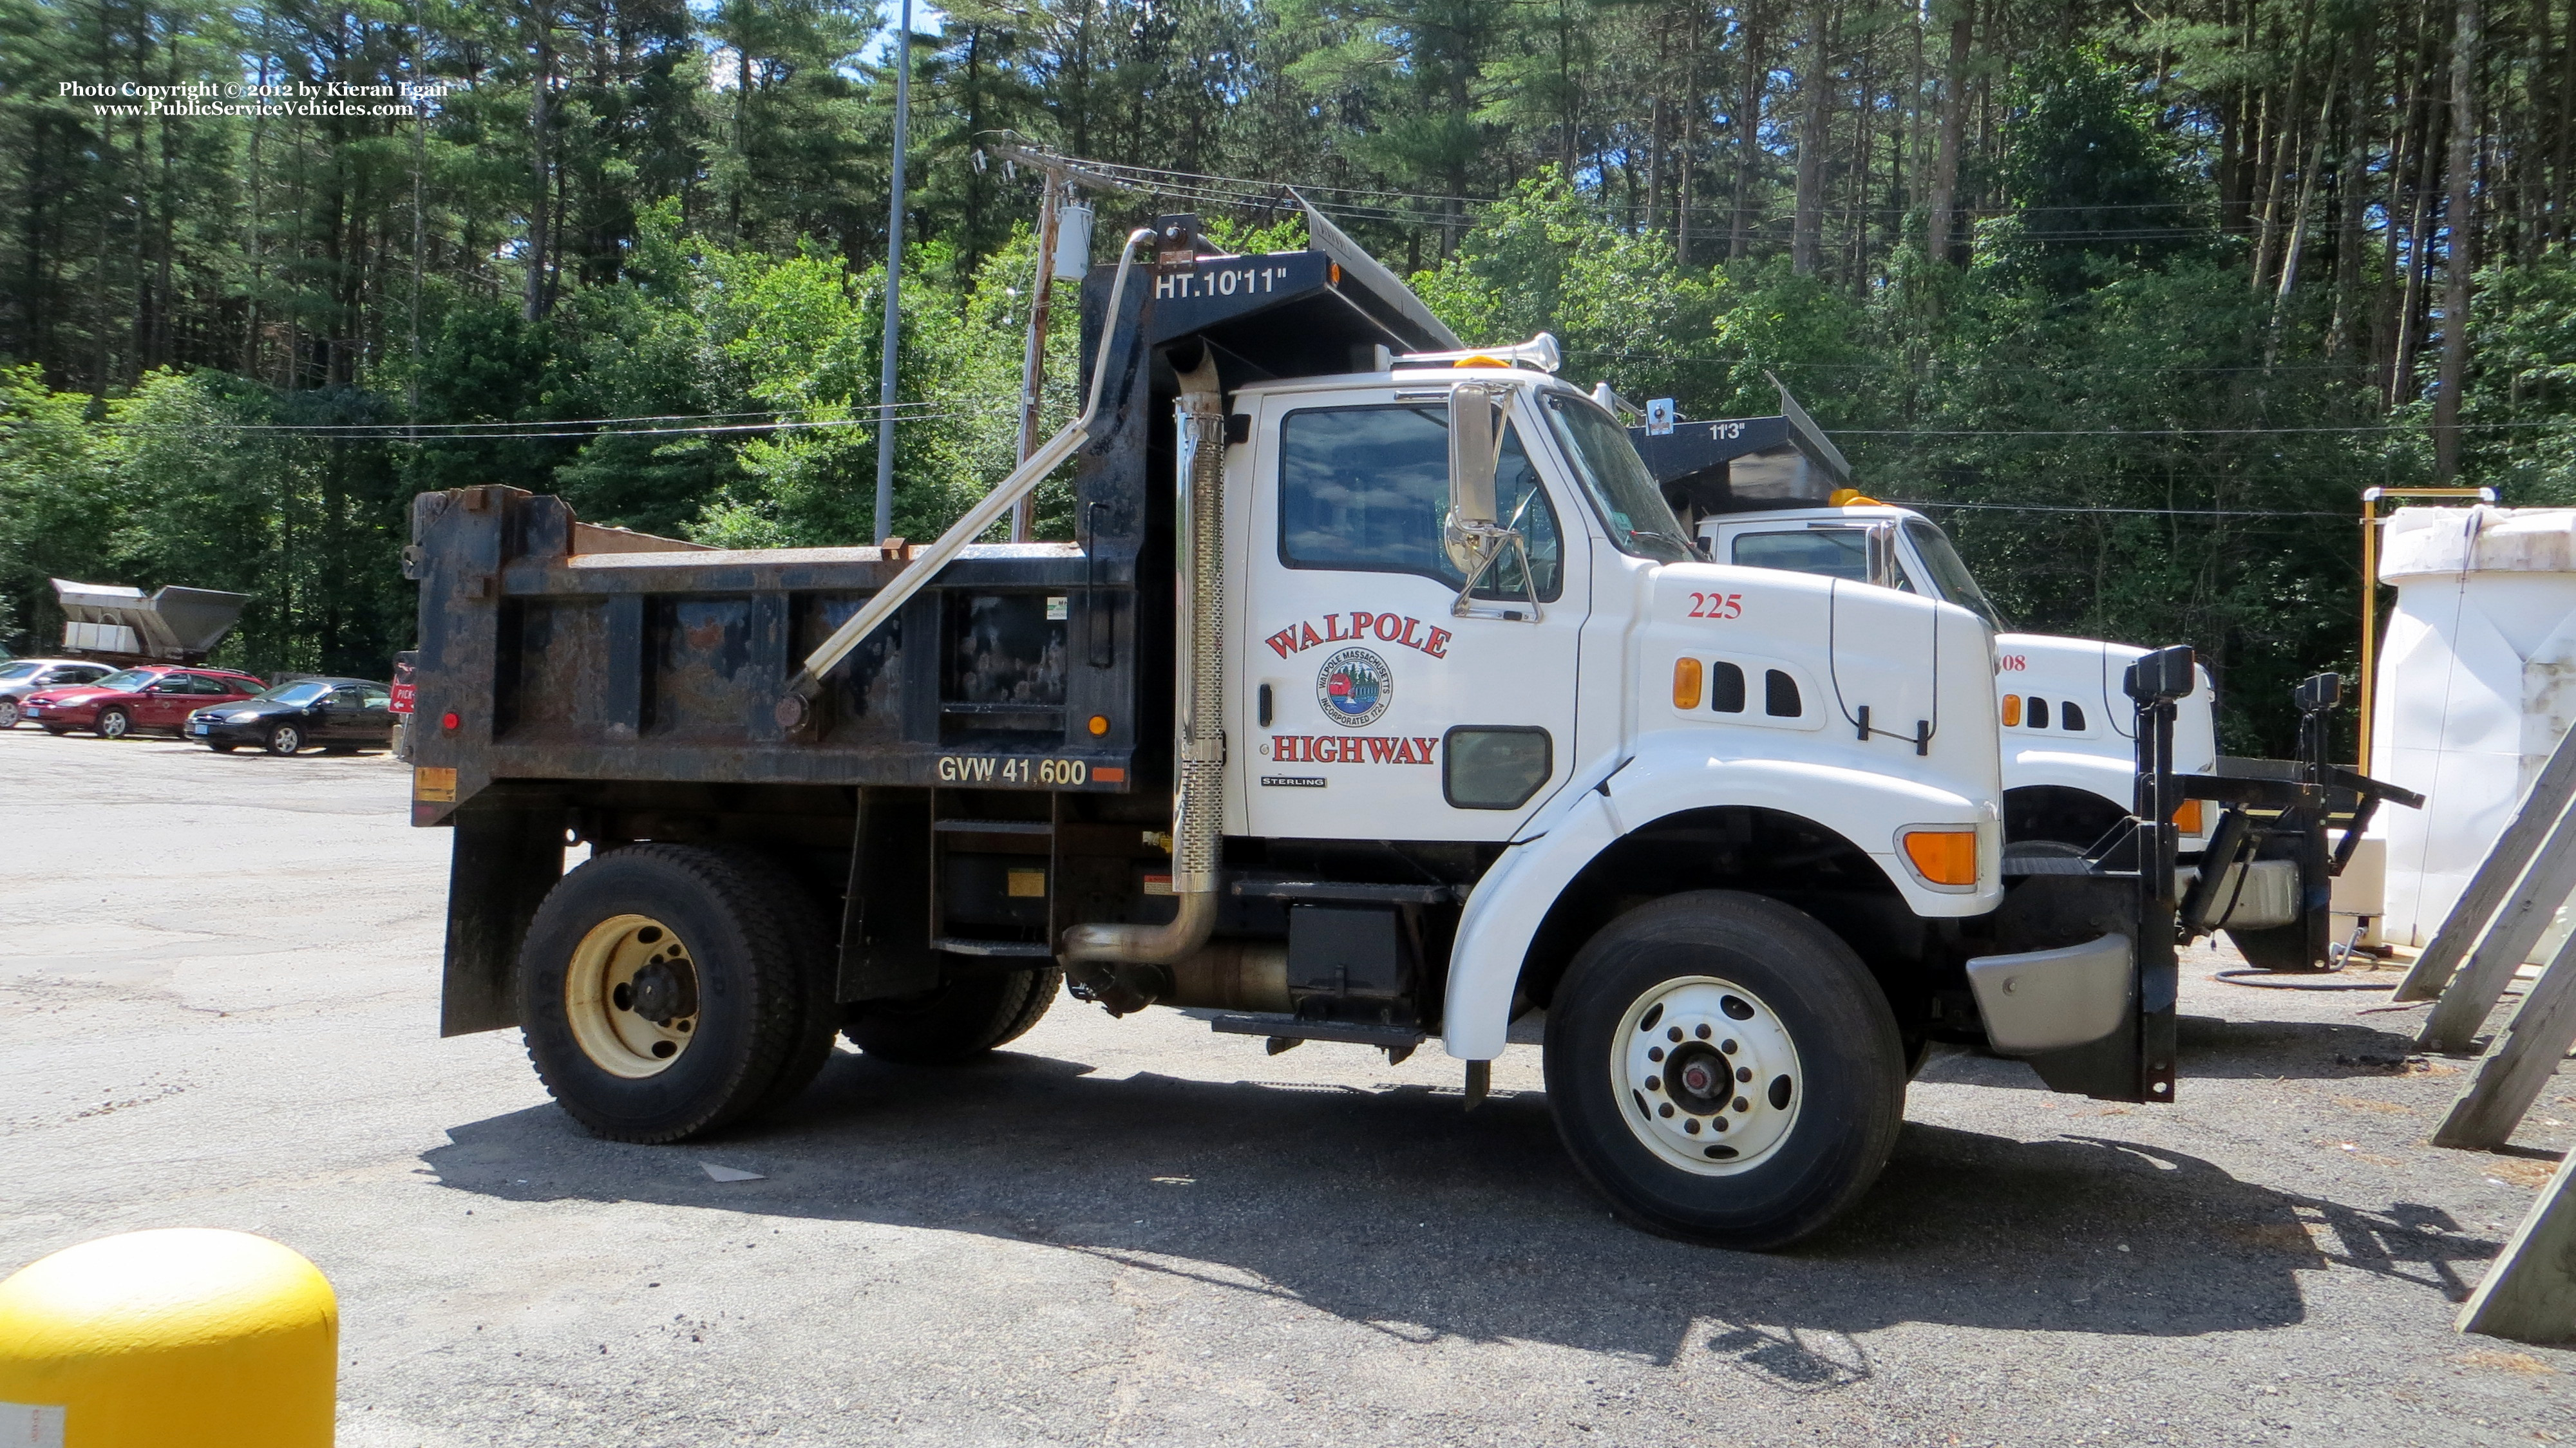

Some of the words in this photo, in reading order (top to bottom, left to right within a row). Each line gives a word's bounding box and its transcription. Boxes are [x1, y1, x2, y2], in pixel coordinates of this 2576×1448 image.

[1687, 592, 1743, 619] 225
[1265, 612, 1452, 660] WALPOLE
[1318, 655, 1342, 689] WALPOLE
[1342, 650, 1390, 695] MASSACHUSETTS
[1998, 655, 2025, 672] 08
[1321, 697, 1370, 725] INCORPORATED
[1370, 702, 1385, 718] 1724
[1271, 735, 1439, 765] HIGHWAY
[938, 756, 996, 782] GVW
[1262, 777, 1324, 785] STERLING
